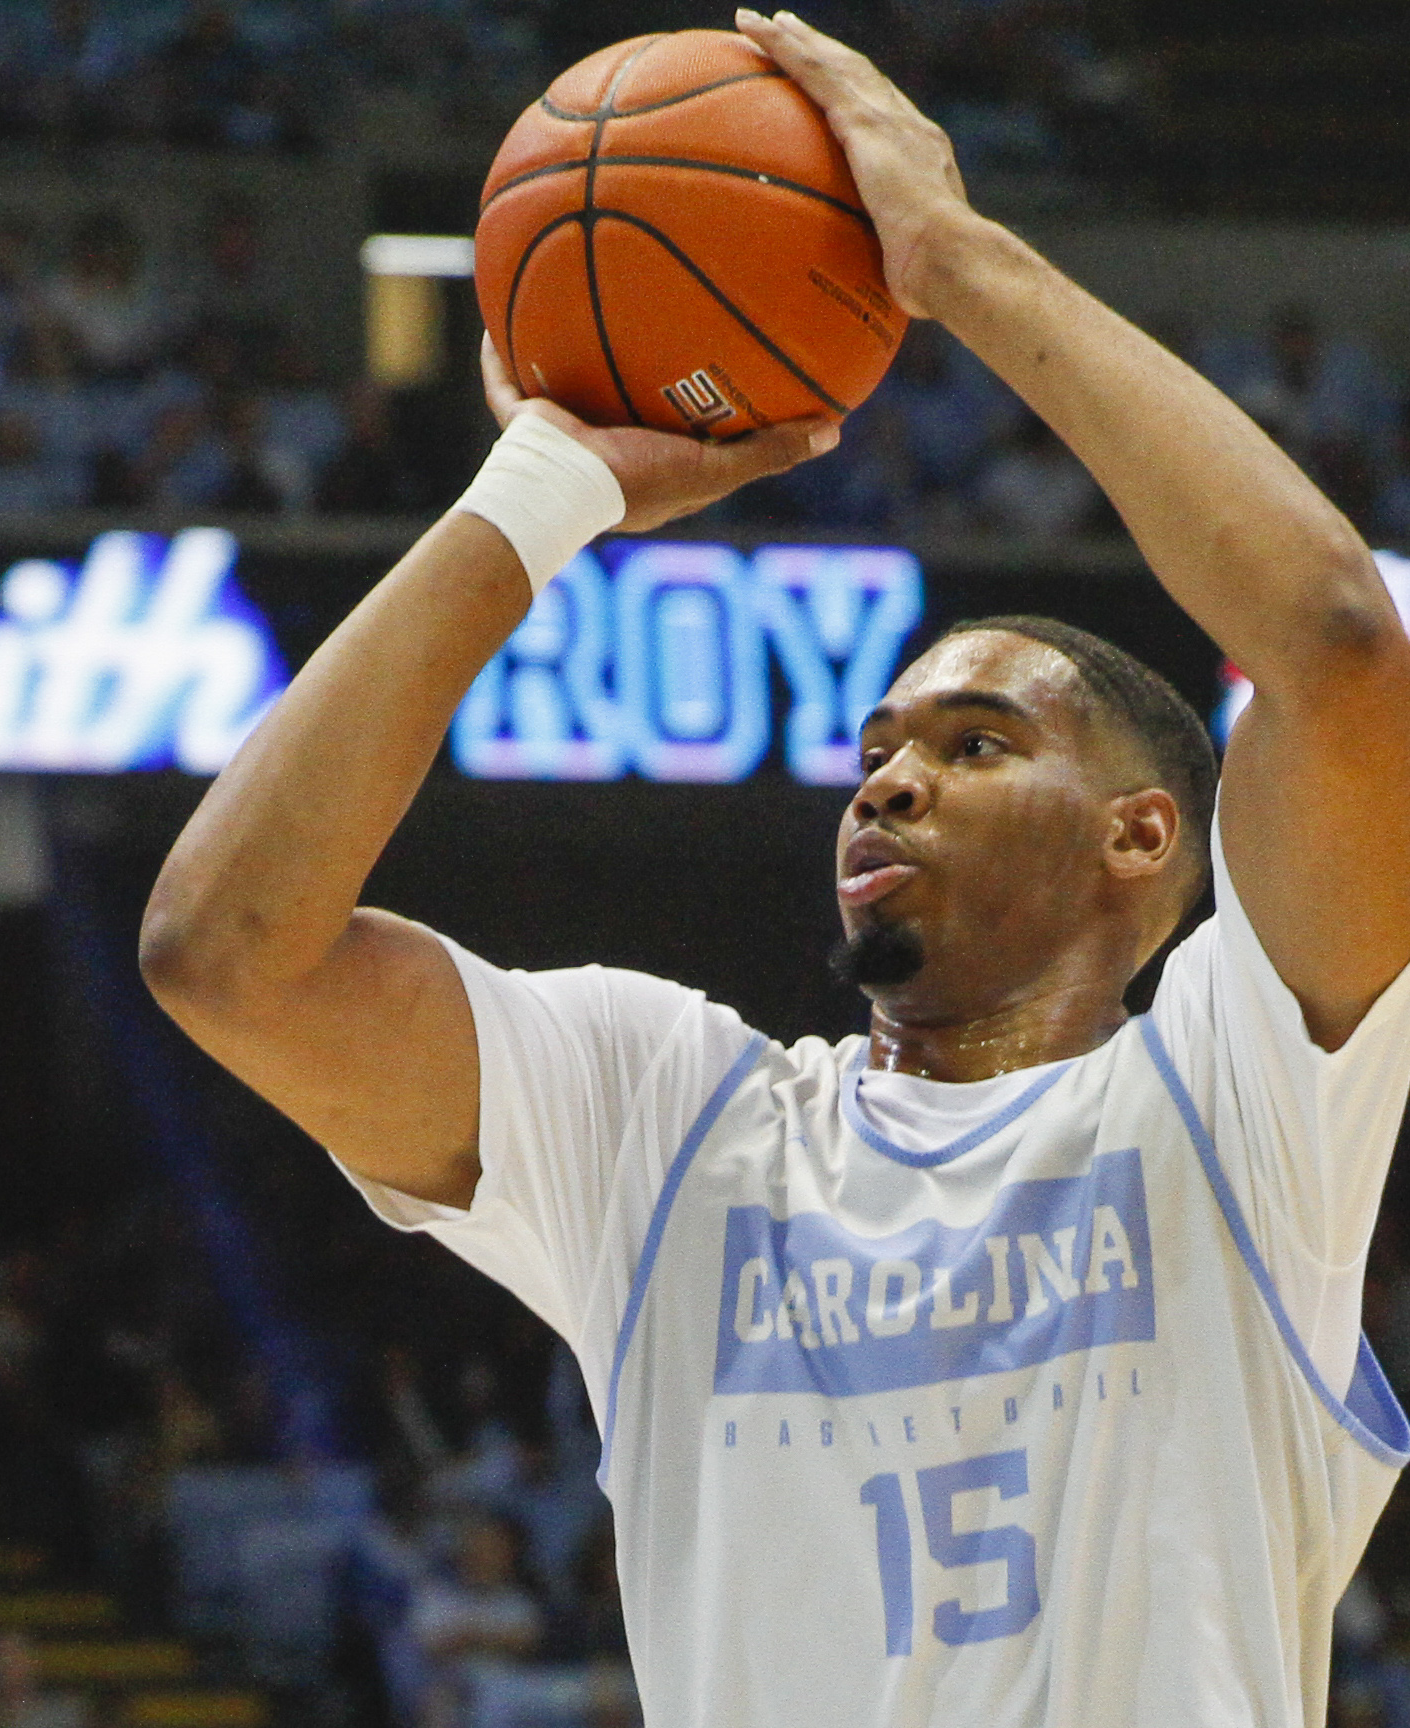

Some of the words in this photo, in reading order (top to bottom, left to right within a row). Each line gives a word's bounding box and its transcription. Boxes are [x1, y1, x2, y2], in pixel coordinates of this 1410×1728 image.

[452, 540, 923, 786] ROY
[733, 1205, 1139, 1350] CAROLINA
[859, 1447, 1041, 1658] 15
